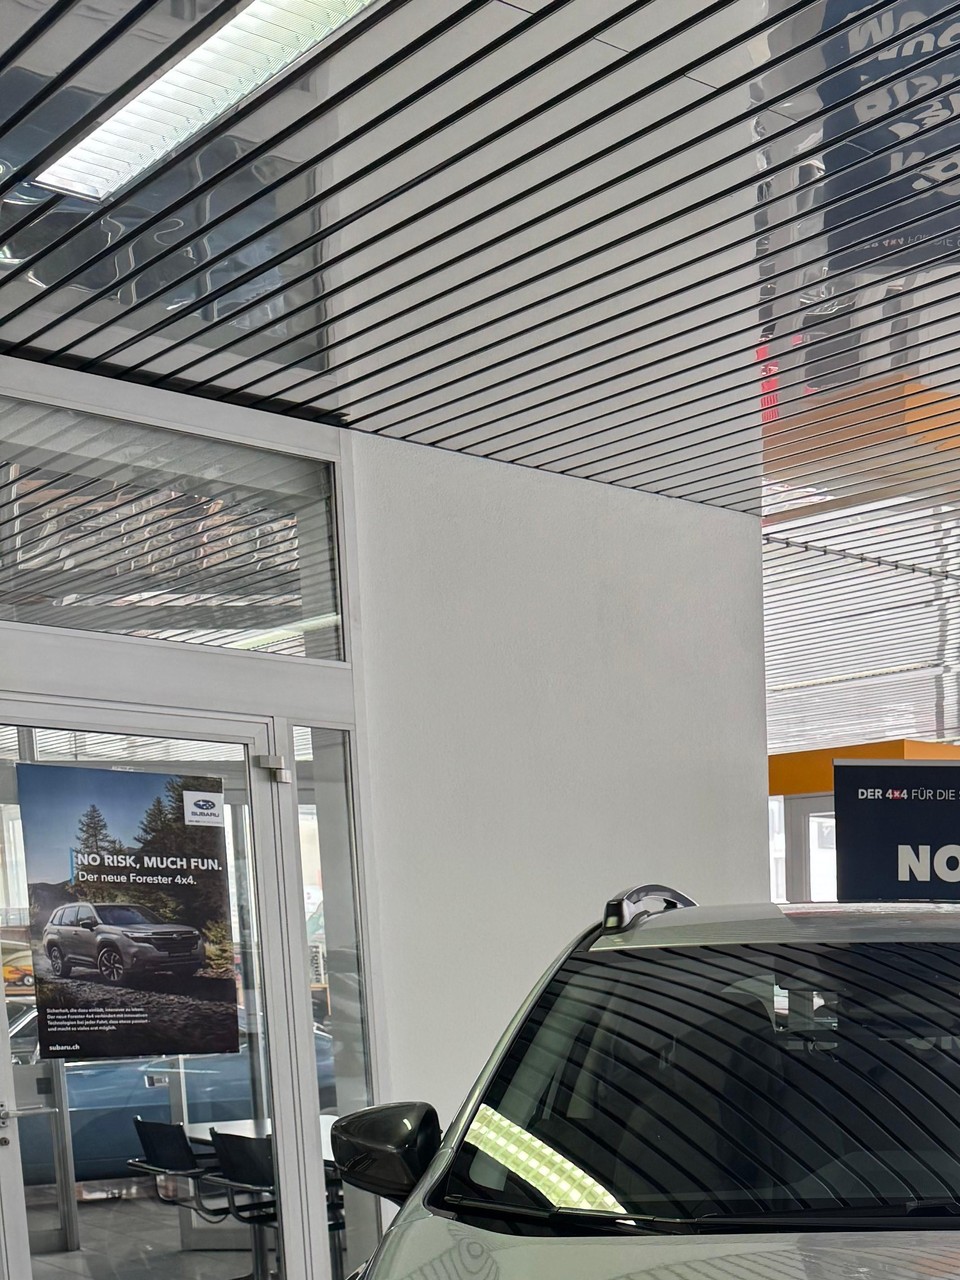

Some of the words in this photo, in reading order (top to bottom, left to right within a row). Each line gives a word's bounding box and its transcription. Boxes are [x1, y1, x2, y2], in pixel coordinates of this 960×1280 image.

[858, 789, 882, 799] DER
[886, 789, 908, 799] 4x4
[912, 788, 933, 800] FÜR
[937, 790, 955, 800] DIE
[78, 854, 100, 865] NO
[104, 855, 140, 869] RISK,
[144, 856, 186, 869] MUCH
[191, 859, 222, 870] FUN.
[79, 872, 98, 881] Der
[101, 874, 127, 882] neue
[130, 874, 172, 884] Forester
[174, 875, 196, 884] 4x4.
